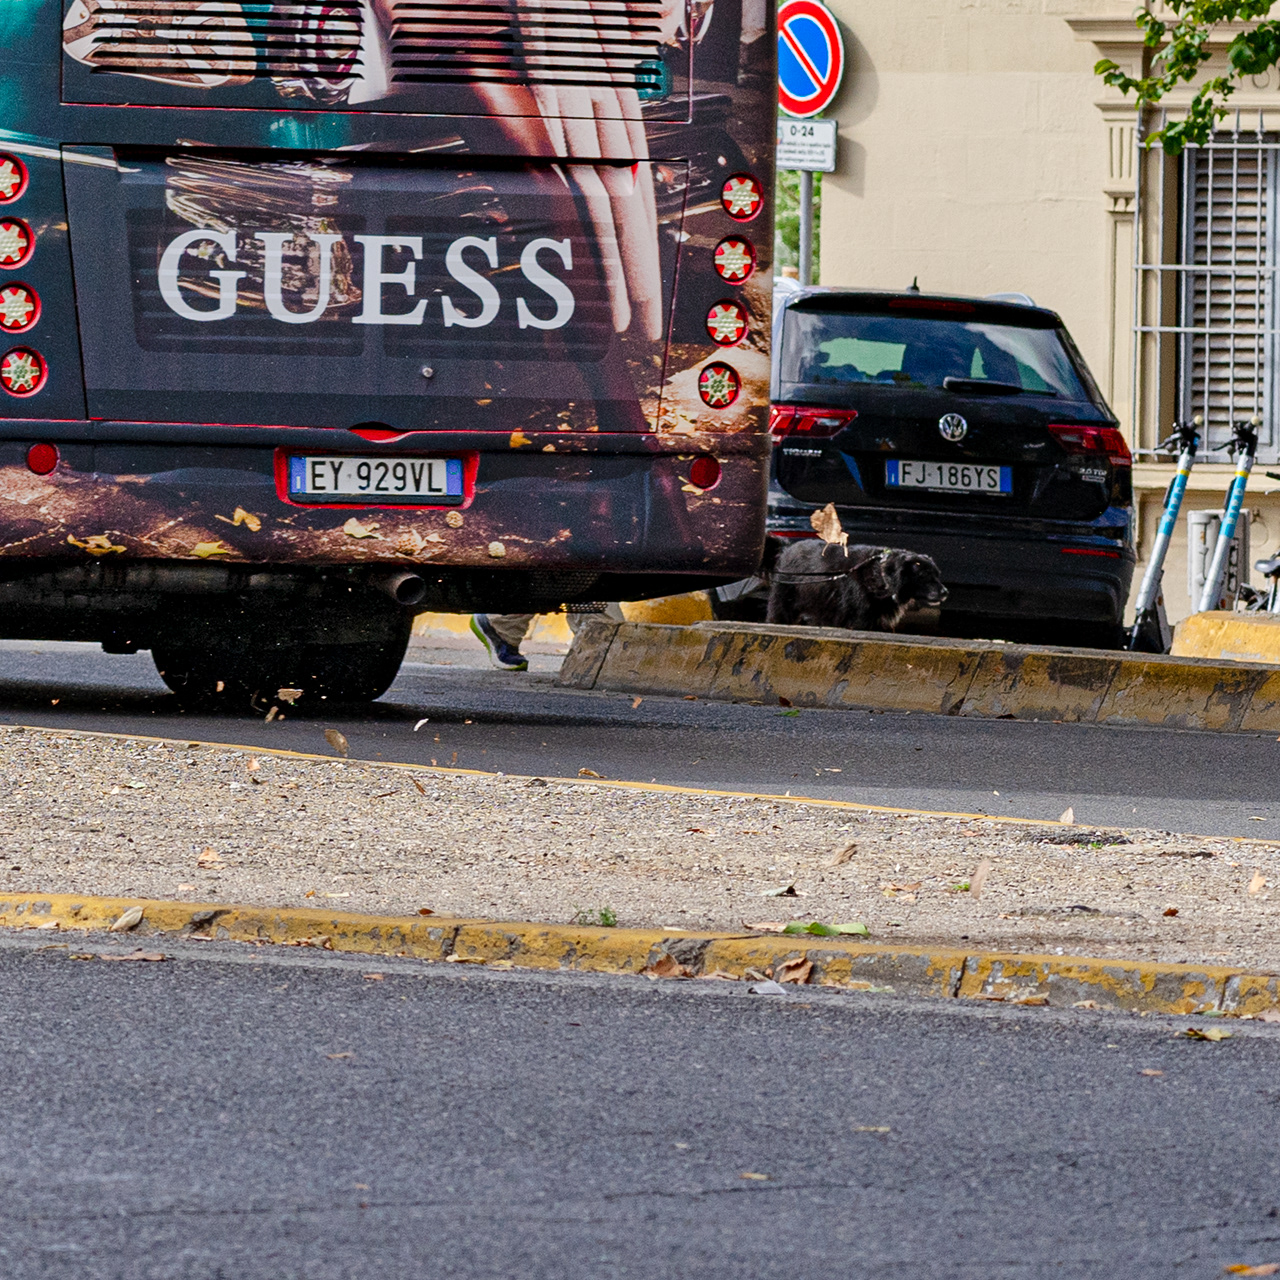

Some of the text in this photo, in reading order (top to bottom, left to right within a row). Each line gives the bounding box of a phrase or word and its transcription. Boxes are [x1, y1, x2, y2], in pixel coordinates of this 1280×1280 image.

[790, 125, 814, 137] 0-24
[157, 229, 576, 330] GUESS
[311, 460, 344, 491] EY
[356, 461, 443, 493] 929VL
[902, 463, 926, 484] FJ
[936, 465, 998, 488] 186YS
